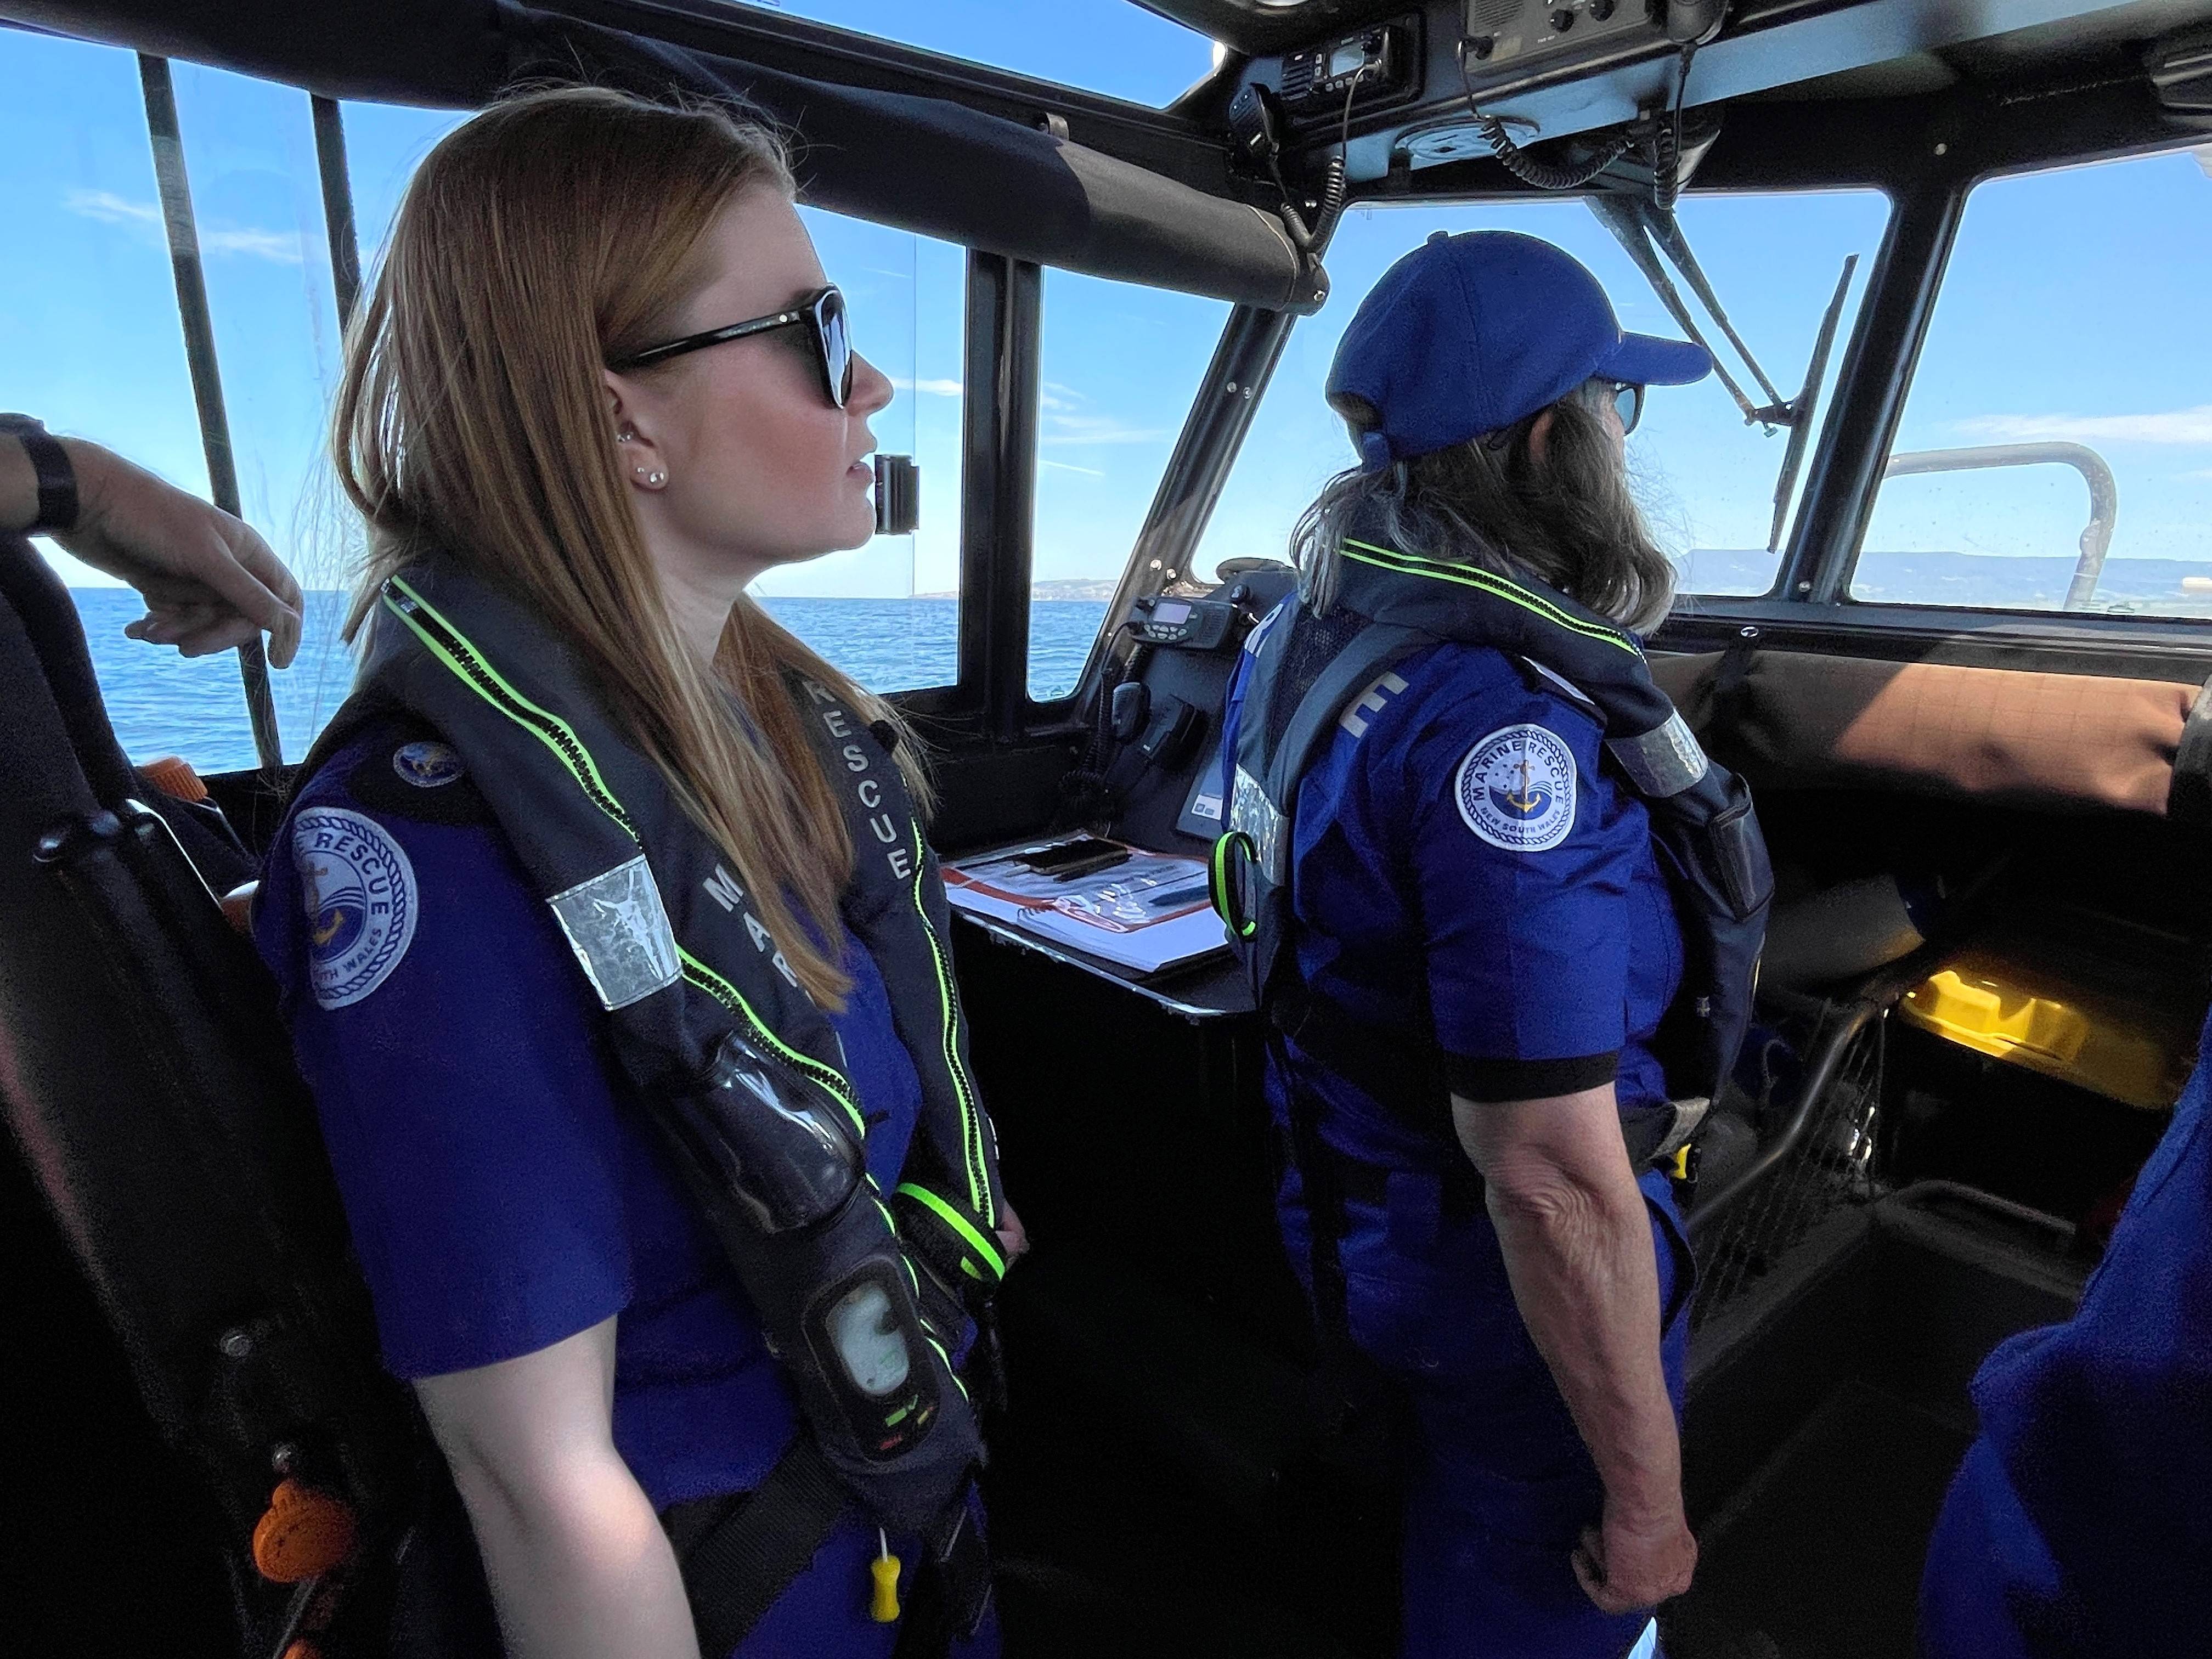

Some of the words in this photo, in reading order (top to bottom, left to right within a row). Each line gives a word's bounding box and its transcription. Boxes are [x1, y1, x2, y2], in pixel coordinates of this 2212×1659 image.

[1473, 741, 1521, 801] MARINE
[1528, 742, 1564, 804] RESCUE
[1481, 807, 1501, 825] NEW
[1502, 823, 1536, 833] SOUTH
[1538, 809, 1560, 831] WALES
[314, 832, 389, 915] RESCUE
[342, 928, 382, 973] WALES
